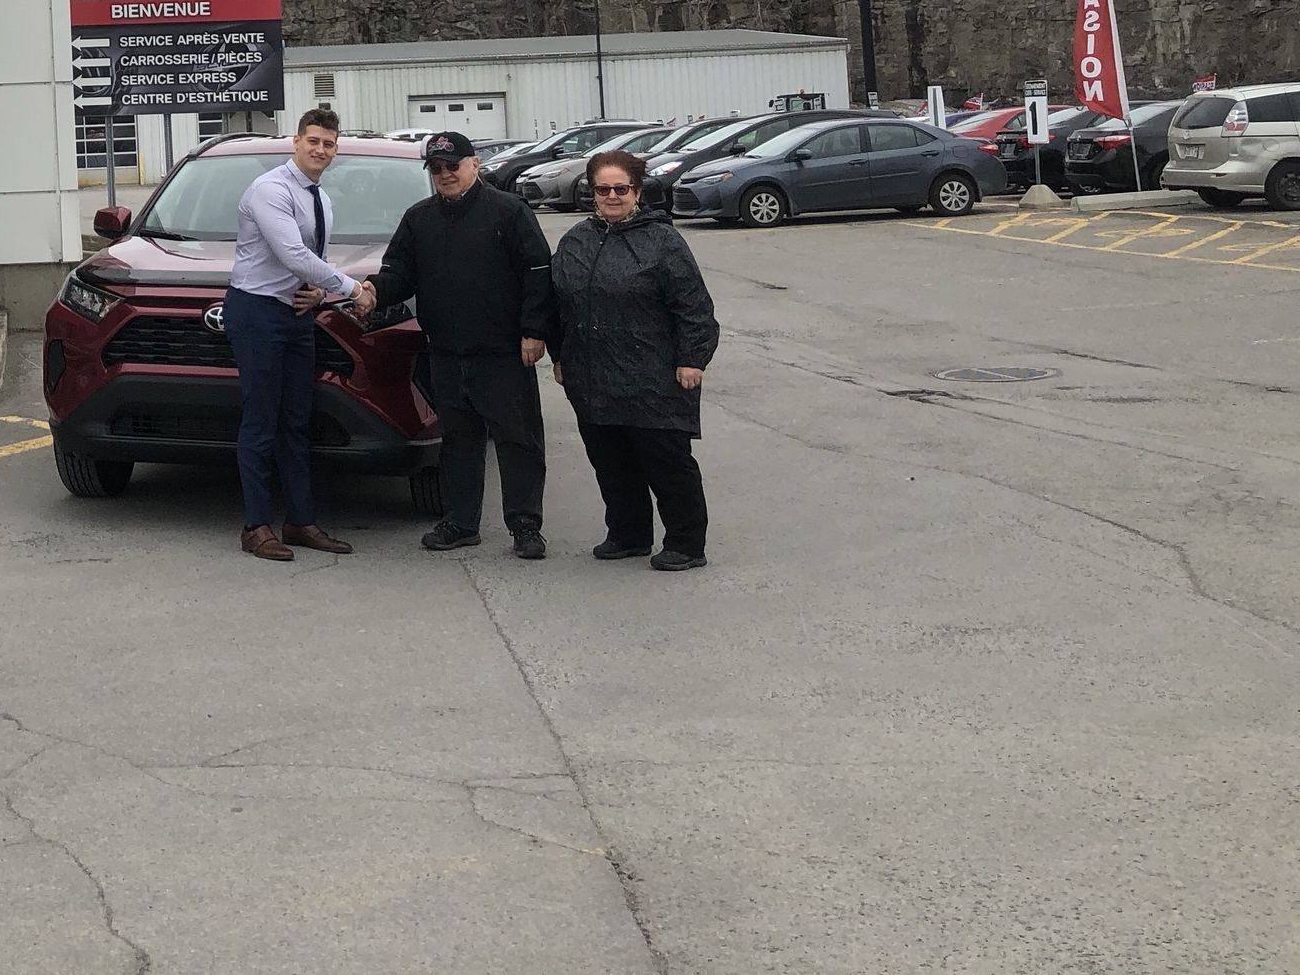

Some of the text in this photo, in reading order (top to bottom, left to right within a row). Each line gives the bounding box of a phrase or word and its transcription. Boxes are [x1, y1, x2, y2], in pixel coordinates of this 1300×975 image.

[111, 1, 211, 19] BIENVENUE
[119, 31, 265, 47] SERVICE APRÈS VENTE
[121, 72, 237, 86] SERVICE EXPRESS
[121, 89, 269, 105] CENTRE D'ESTHÉTIQUE
[1028, 100, 1038, 136] 1
